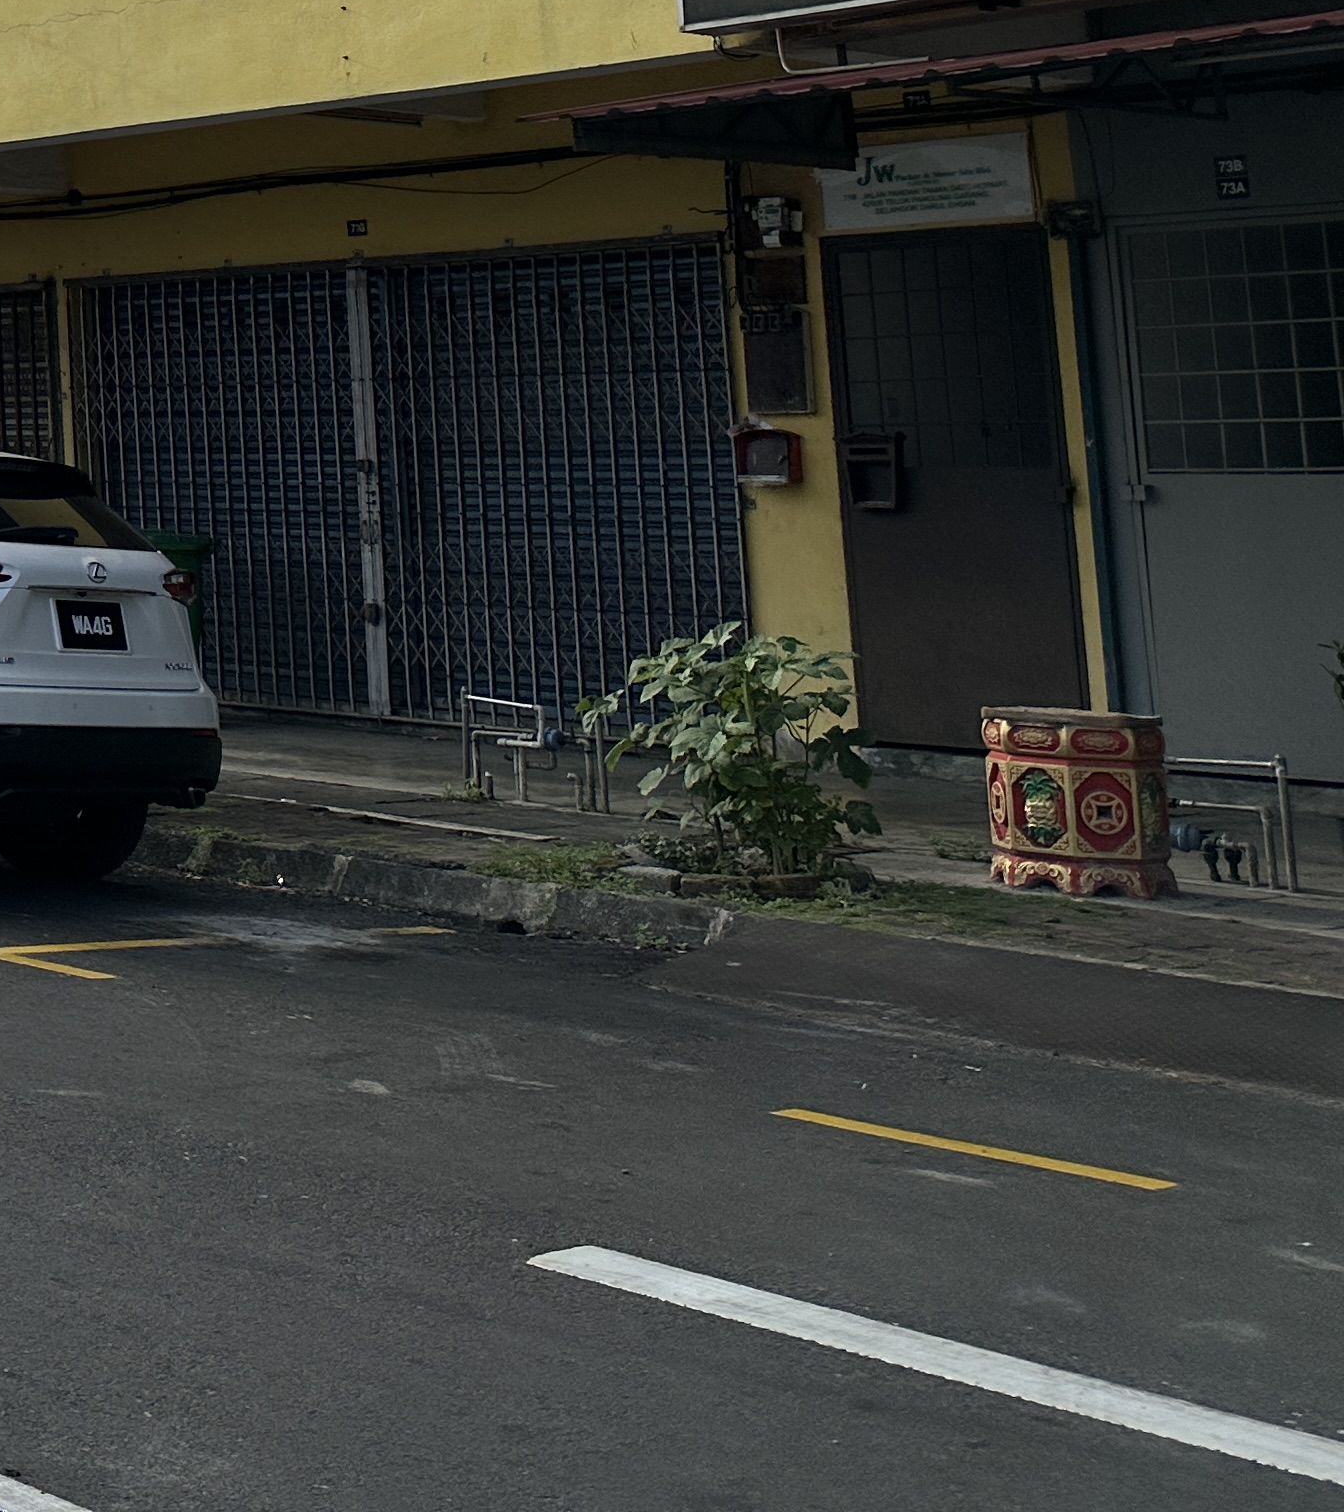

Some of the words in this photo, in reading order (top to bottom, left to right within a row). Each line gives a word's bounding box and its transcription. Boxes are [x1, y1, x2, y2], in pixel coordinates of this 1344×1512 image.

[1218, 159, 1244, 173] 73B
[1220, 181, 1247, 196] 73A
[72, 614, 113, 636] WA4G
